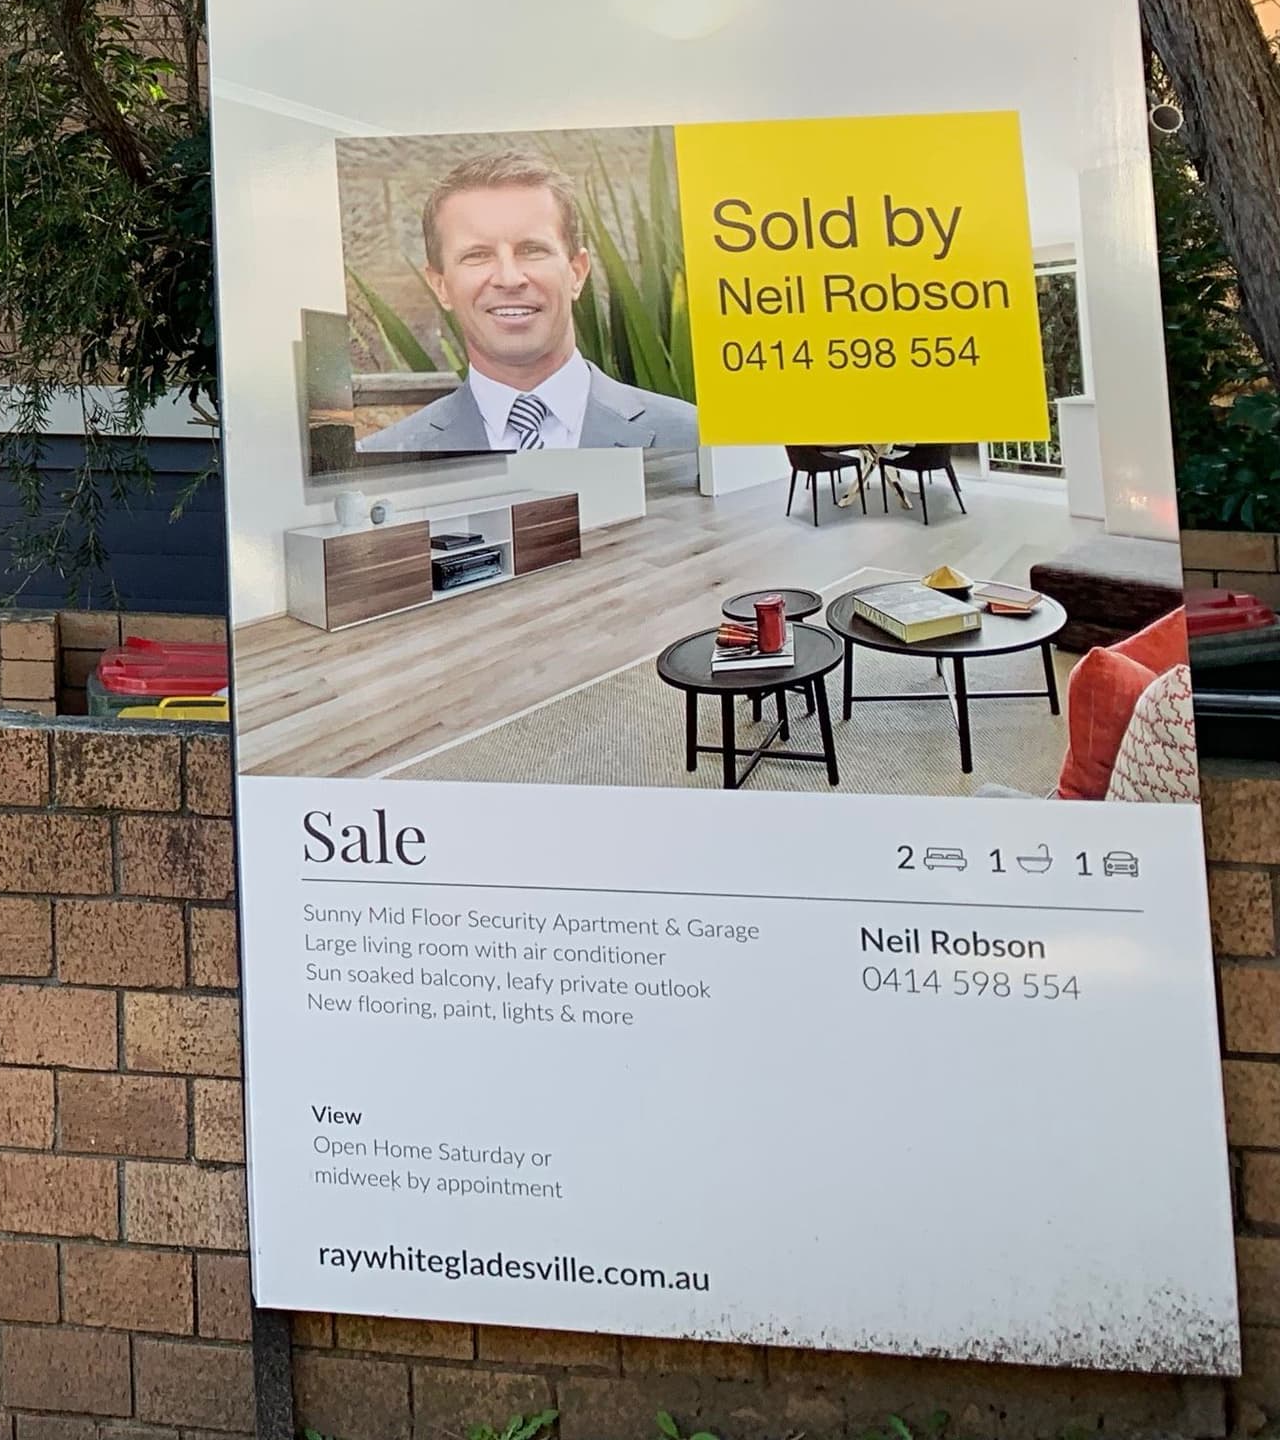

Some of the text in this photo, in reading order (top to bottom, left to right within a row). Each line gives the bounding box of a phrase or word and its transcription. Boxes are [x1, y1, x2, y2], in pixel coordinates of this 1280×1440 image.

[713, 194, 962, 260] Sold by
[718, 273, 1010, 316] Neil Robson
[722, 336, 980, 372] 0414 598 554
[303, 808, 427, 865] Sale
[897, 845, 1093, 876] 2 1 1
[303, 903, 760, 943] Sunny Mid Floor Security Apartment & Garage
[305, 934, 667, 966] Large living room with air conditioner
[860, 926, 1046, 959] Neil Robson
[306, 963, 711, 998] Sun soaked balcony, leafy private outlook
[862, 965, 1081, 1000] 0414 598 554
[308, 993, 634, 1025] New flooring, paint, lights & more
[311, 1105, 362, 1126] View
[313, 1135, 552, 1168] Open Home Saturday or
[314, 1167, 564, 1199] midweek by appointment
[319, 1244, 710, 1291] raywhitegladesville.com.au
